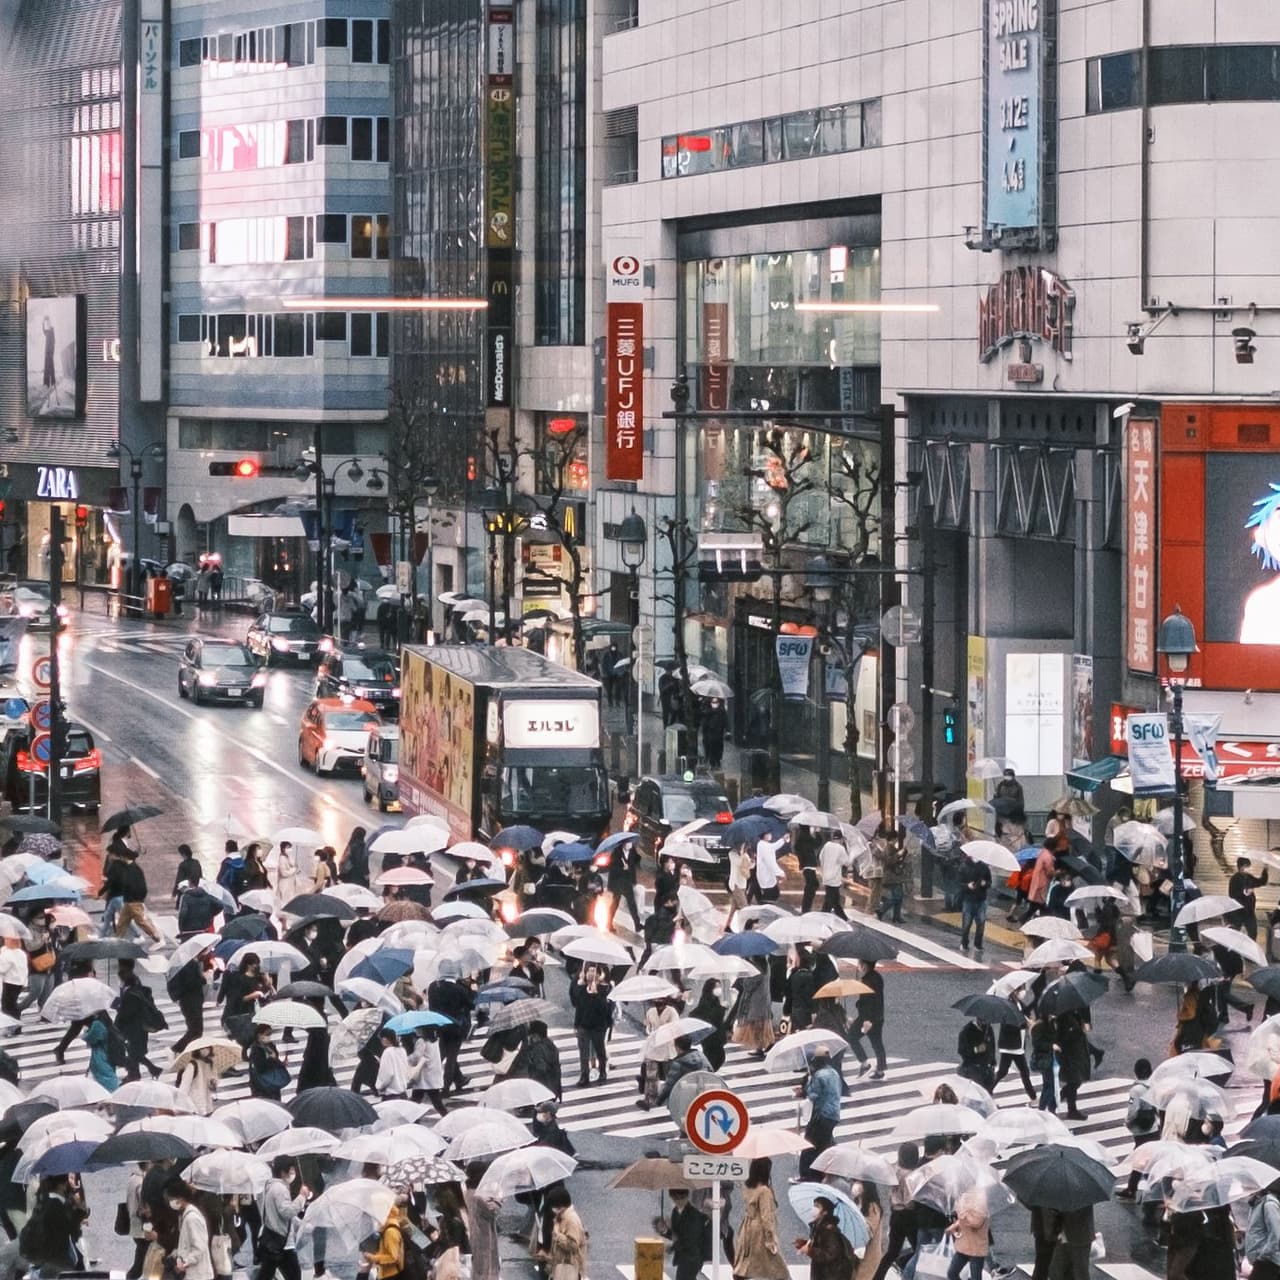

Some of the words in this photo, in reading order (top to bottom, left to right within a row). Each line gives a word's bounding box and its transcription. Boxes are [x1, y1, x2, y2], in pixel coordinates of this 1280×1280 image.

[999, 38, 1028, 72] SALE
[612, 278, 640, 287] MUFG
[493, 334, 505, 403] McDonald's
[616, 318, 636, 449] 三菱UFJ銀行
[37, 466, 78, 499] ZARA
[1133, 460, 1150, 663] 天津甘栗
[778, 642, 809, 657] SFW
[527, 719, 575, 733] エルコレ
[1131, 723, 1165, 740] SFW
[688, 1161, 745, 1177] ここから
